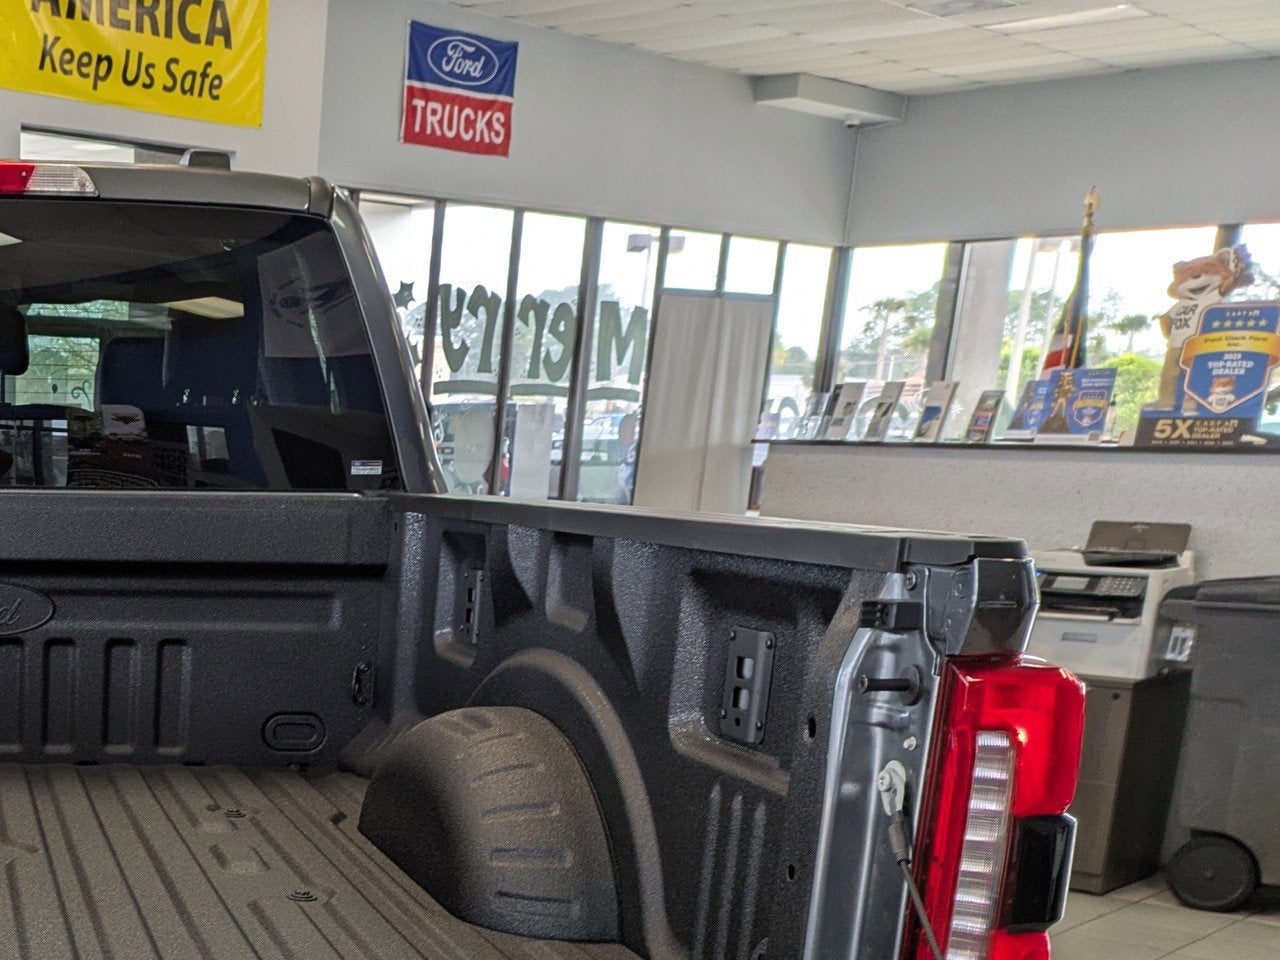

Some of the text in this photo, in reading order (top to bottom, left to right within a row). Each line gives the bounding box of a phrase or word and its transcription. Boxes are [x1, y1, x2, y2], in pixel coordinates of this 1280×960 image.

[37, 33, 224, 100] Keep Us Safe
[441, 41, 486, 78] Ford
[411, 98, 505, 145] TRUCKS
[1153, 419, 1194, 439] 5X
